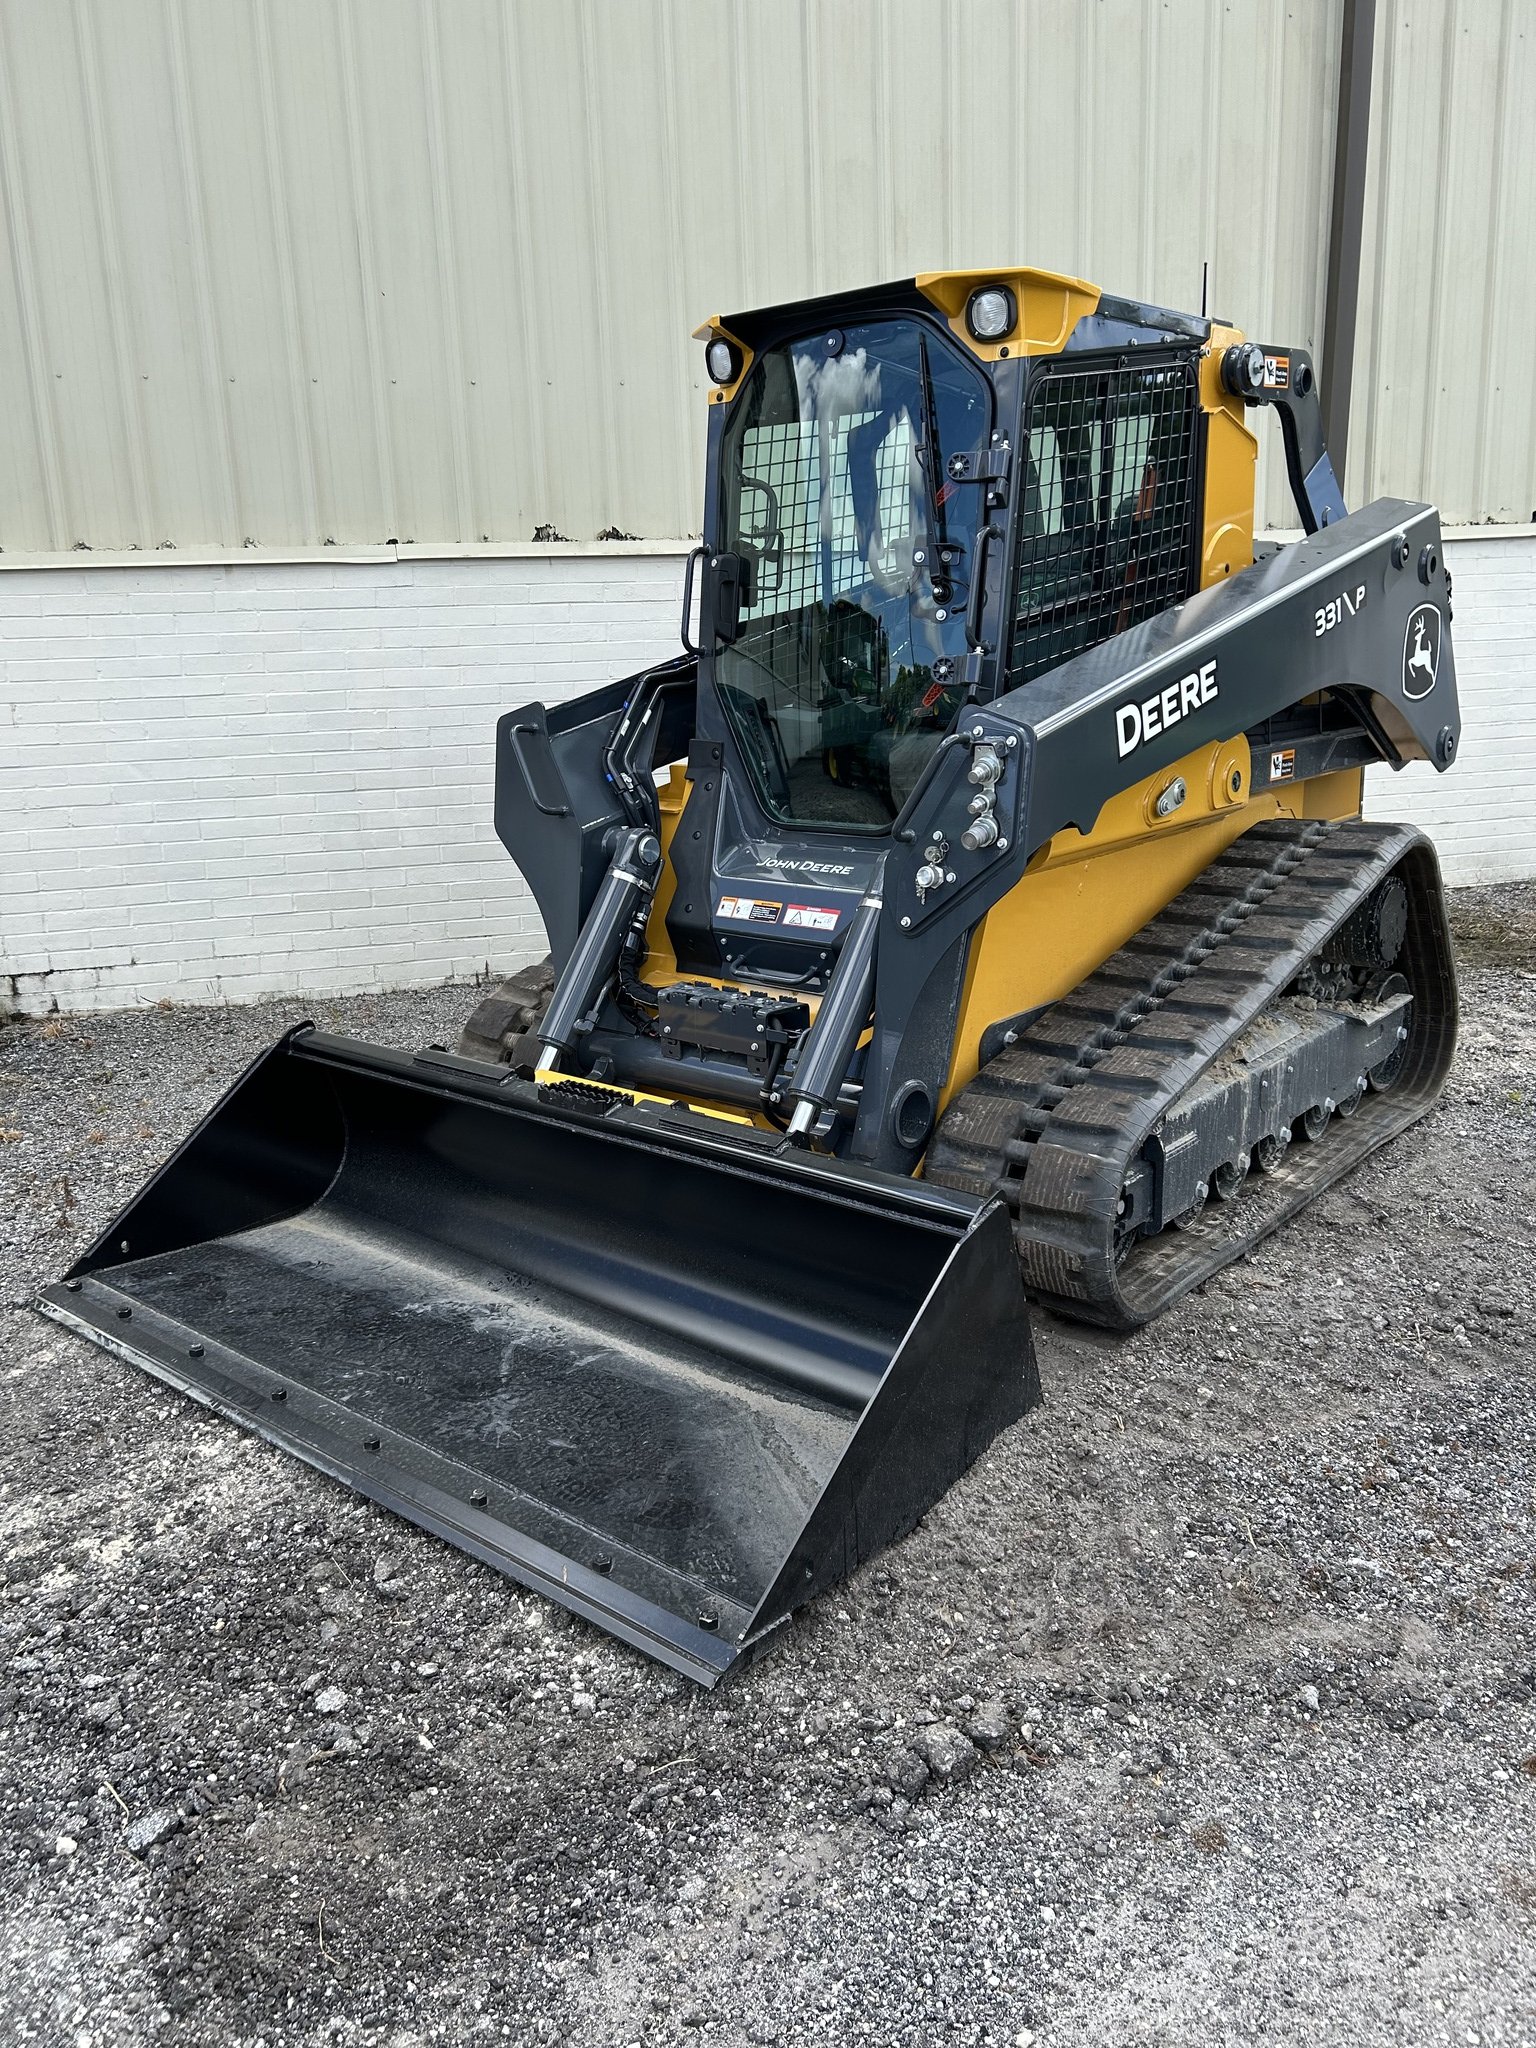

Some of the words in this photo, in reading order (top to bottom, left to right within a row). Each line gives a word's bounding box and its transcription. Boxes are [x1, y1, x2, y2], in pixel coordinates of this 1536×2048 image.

[1115, 659, 1219, 758] DEERE
[756, 857, 801, 870] JOHN
[799, 860, 855, 875] DEERE
